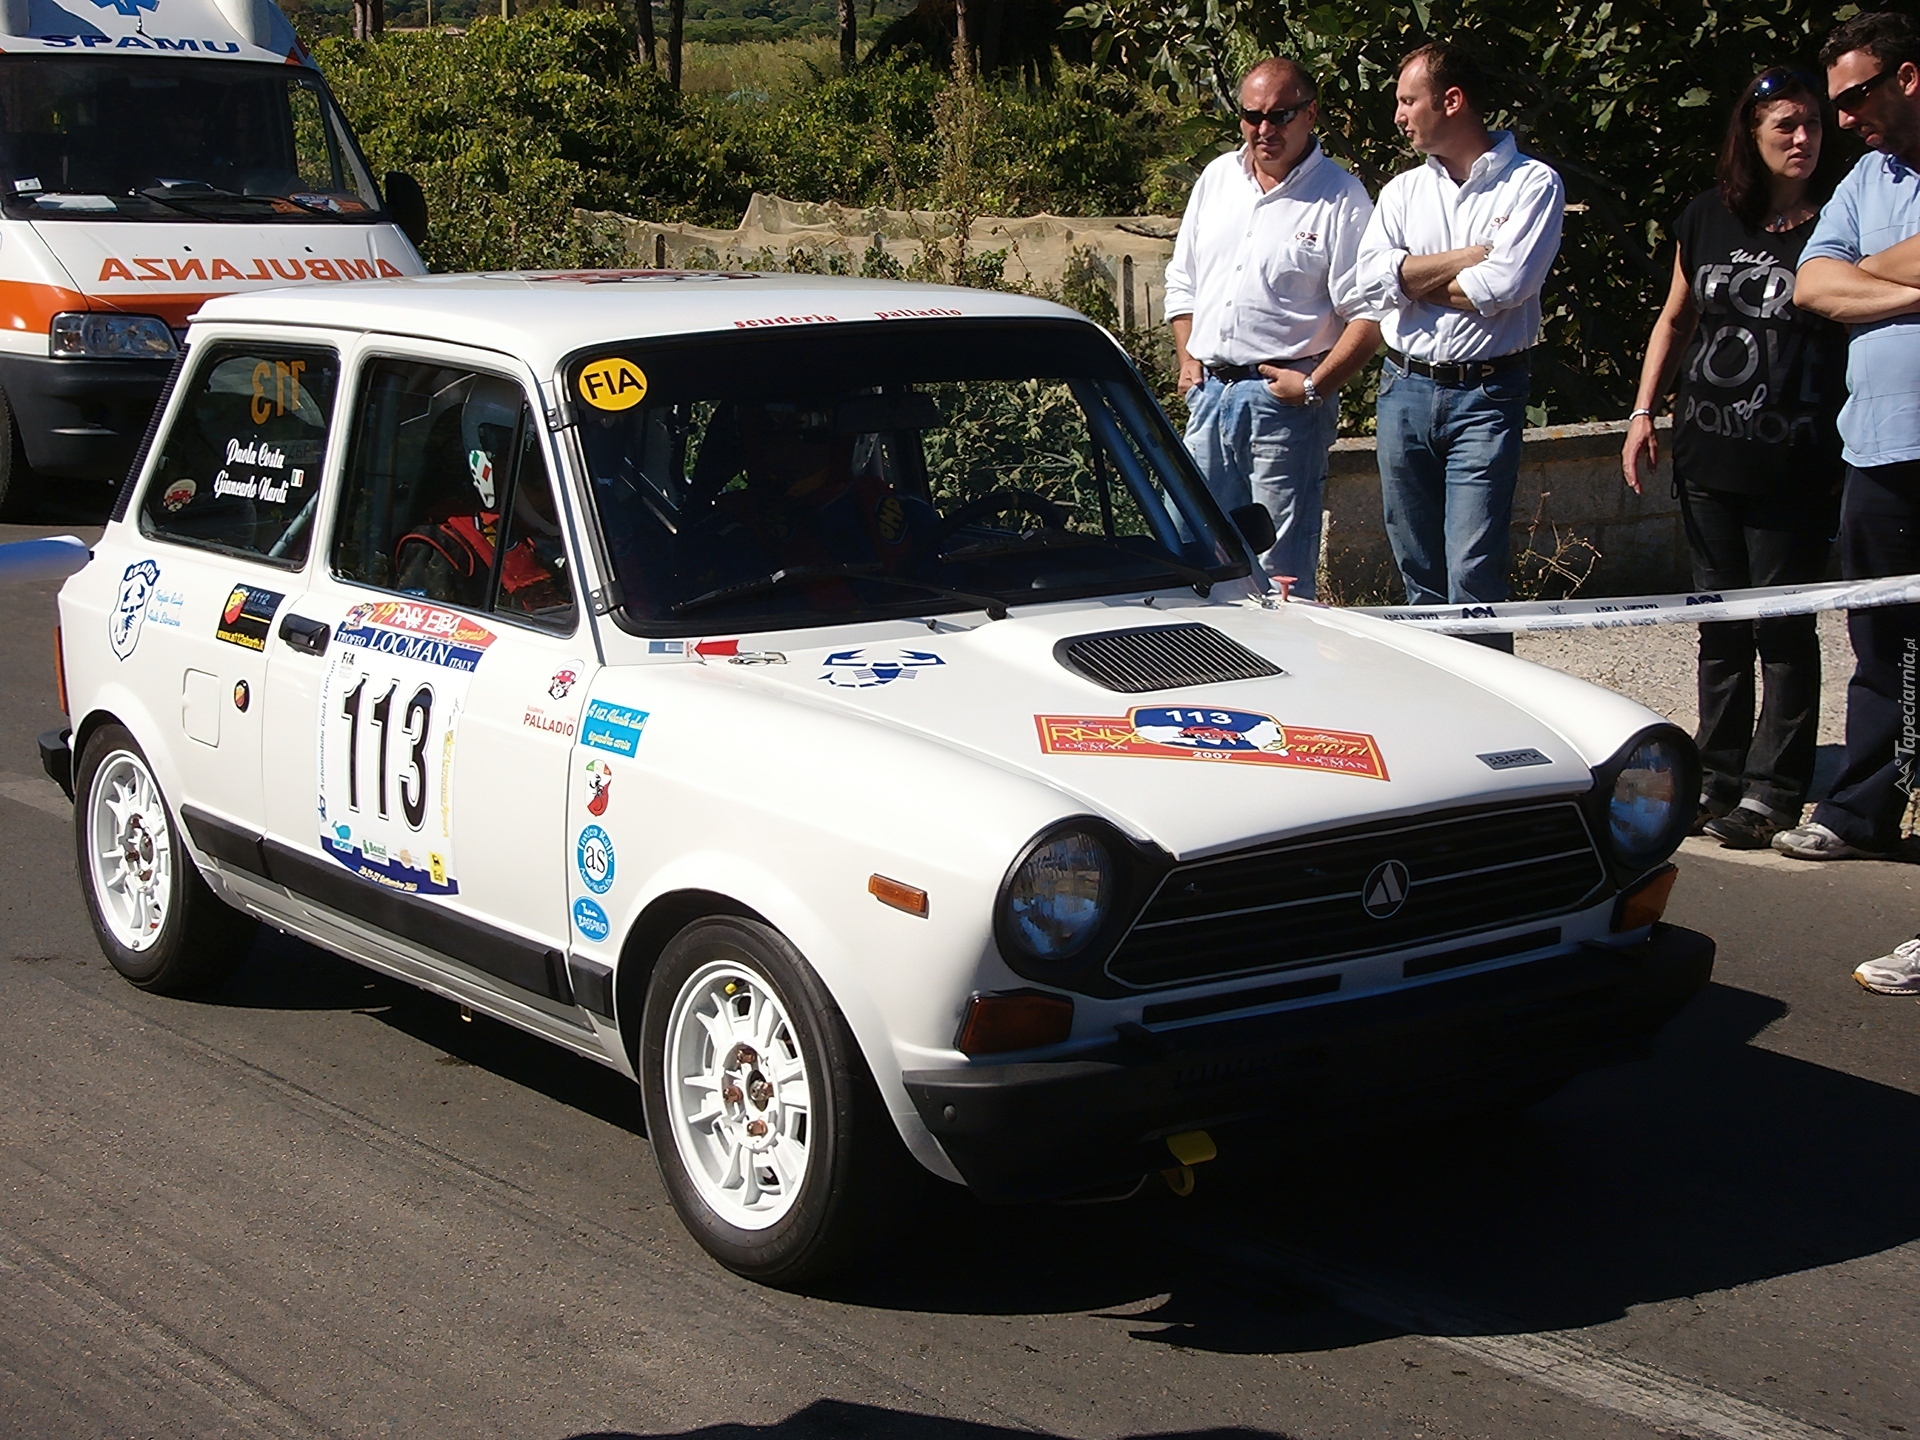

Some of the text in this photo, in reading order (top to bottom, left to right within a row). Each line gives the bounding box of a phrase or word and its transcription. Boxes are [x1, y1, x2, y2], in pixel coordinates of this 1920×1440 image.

[40, 34, 241, 54] SPAMU
[1729, 247, 1780, 281] my
[733, 307, 963, 329] scuderia palladio
[584, 367, 645, 401] FIA
[1732, 382, 1769, 421] of
[257, 442, 286, 469] Costa
[336, 631, 367, 647] TROFEO
[368, 629, 454, 666] LOCMAN
[449, 657, 475, 672] ITALY
[523, 712, 575, 737] PALLADIO
[1165, 709, 1233, 725] 113
[341, 672, 437, 833] 113
[1192, 750, 1232, 759] 2007
[1488, 752, 1540, 766] ABARTH
[585, 845, 606, 874] as
